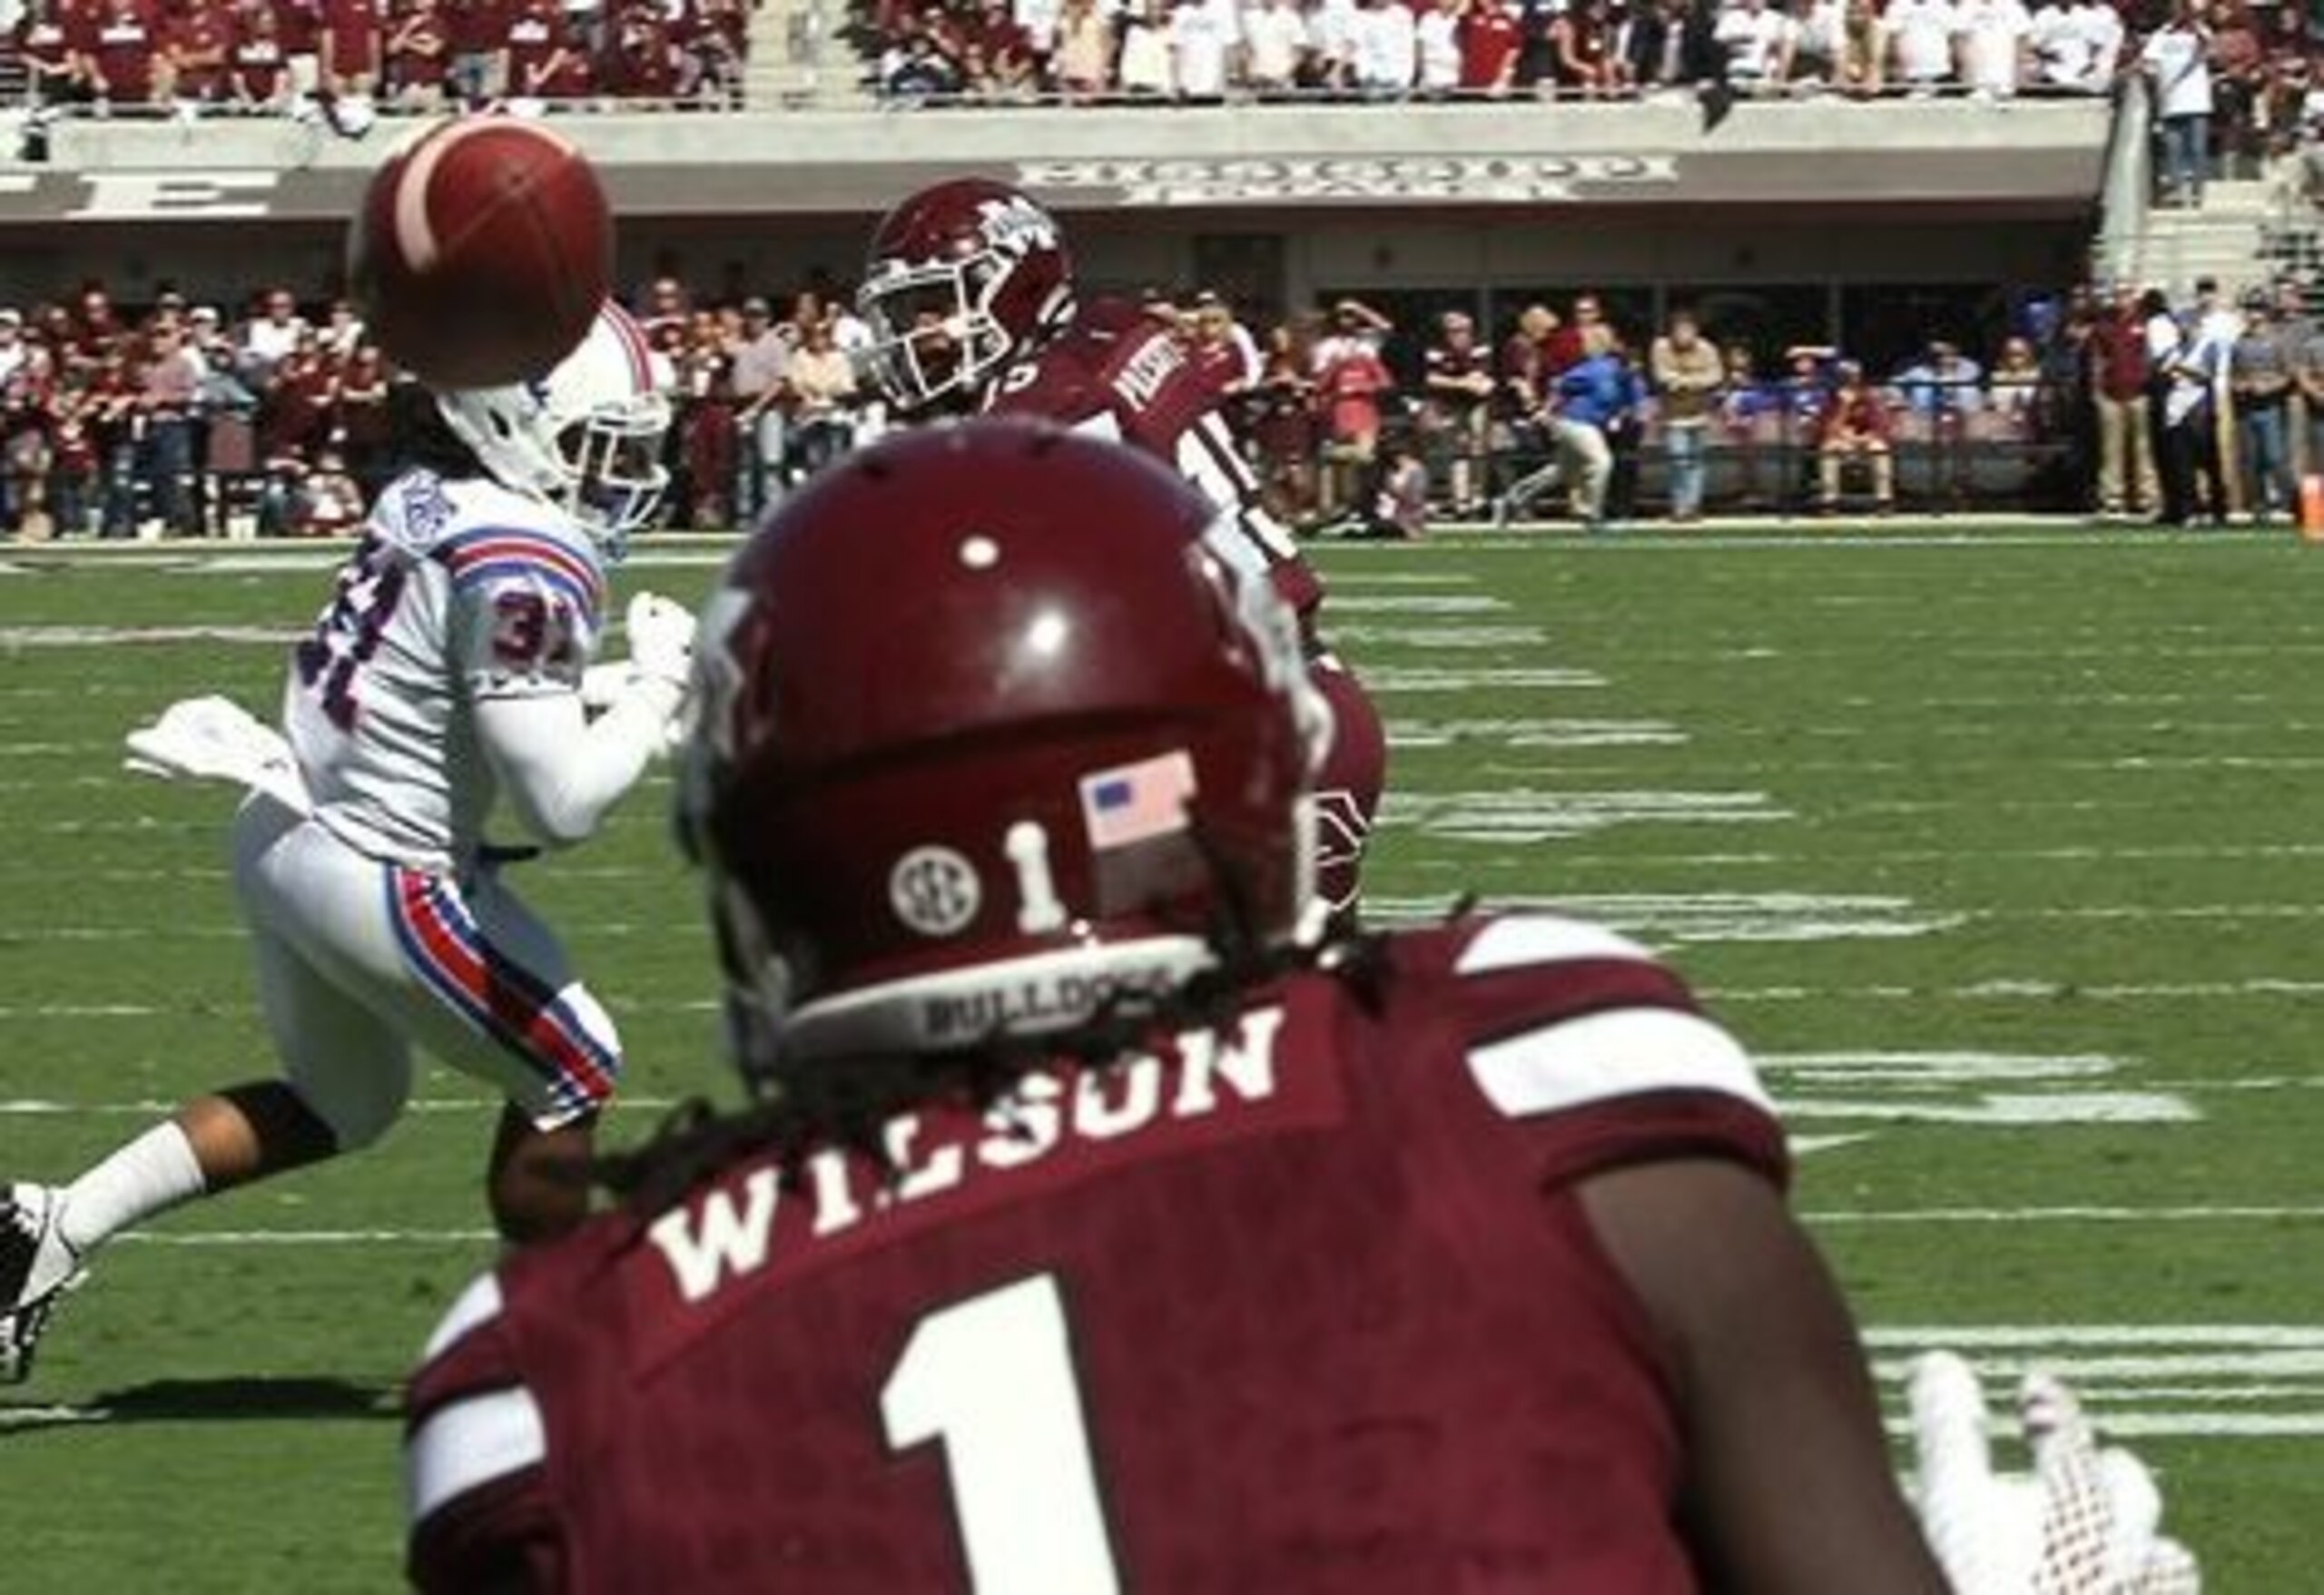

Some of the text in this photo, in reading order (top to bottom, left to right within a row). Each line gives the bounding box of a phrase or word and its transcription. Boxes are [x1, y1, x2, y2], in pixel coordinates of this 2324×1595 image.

[1005, 821, 1067, 933] 1
[647, 1006, 1285, 1304] WILSON
[879, 1271, 1122, 1595] 1
